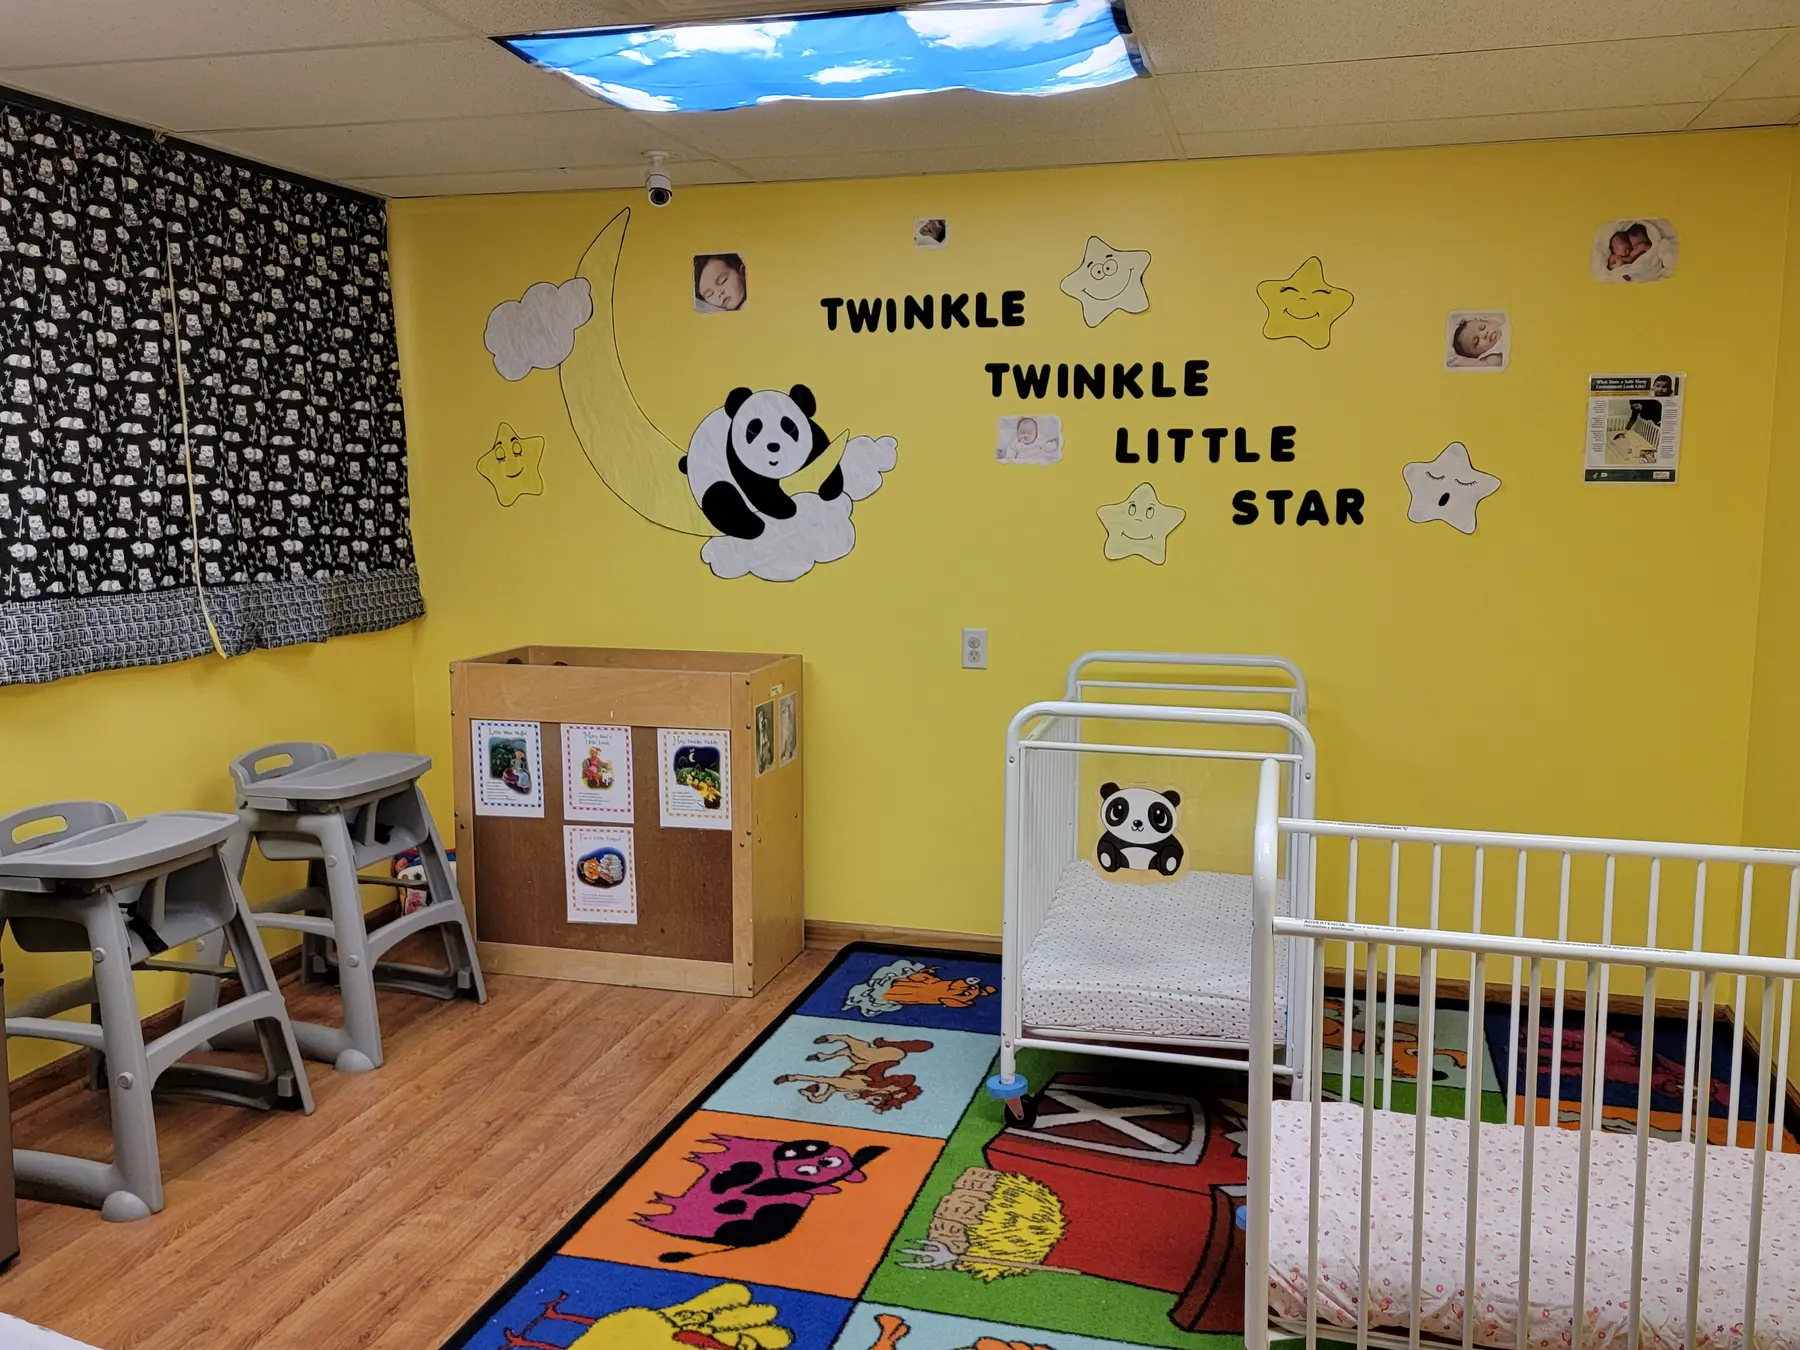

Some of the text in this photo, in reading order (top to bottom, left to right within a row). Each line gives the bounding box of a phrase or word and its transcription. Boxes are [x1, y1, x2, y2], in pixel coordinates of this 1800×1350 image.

[820, 290, 1026, 334] TWINKLE
[984, 359, 1210, 400] TWINKLE
[1115, 425, 1297, 464] LITTLE
[1231, 488, 1365, 527] STAR
